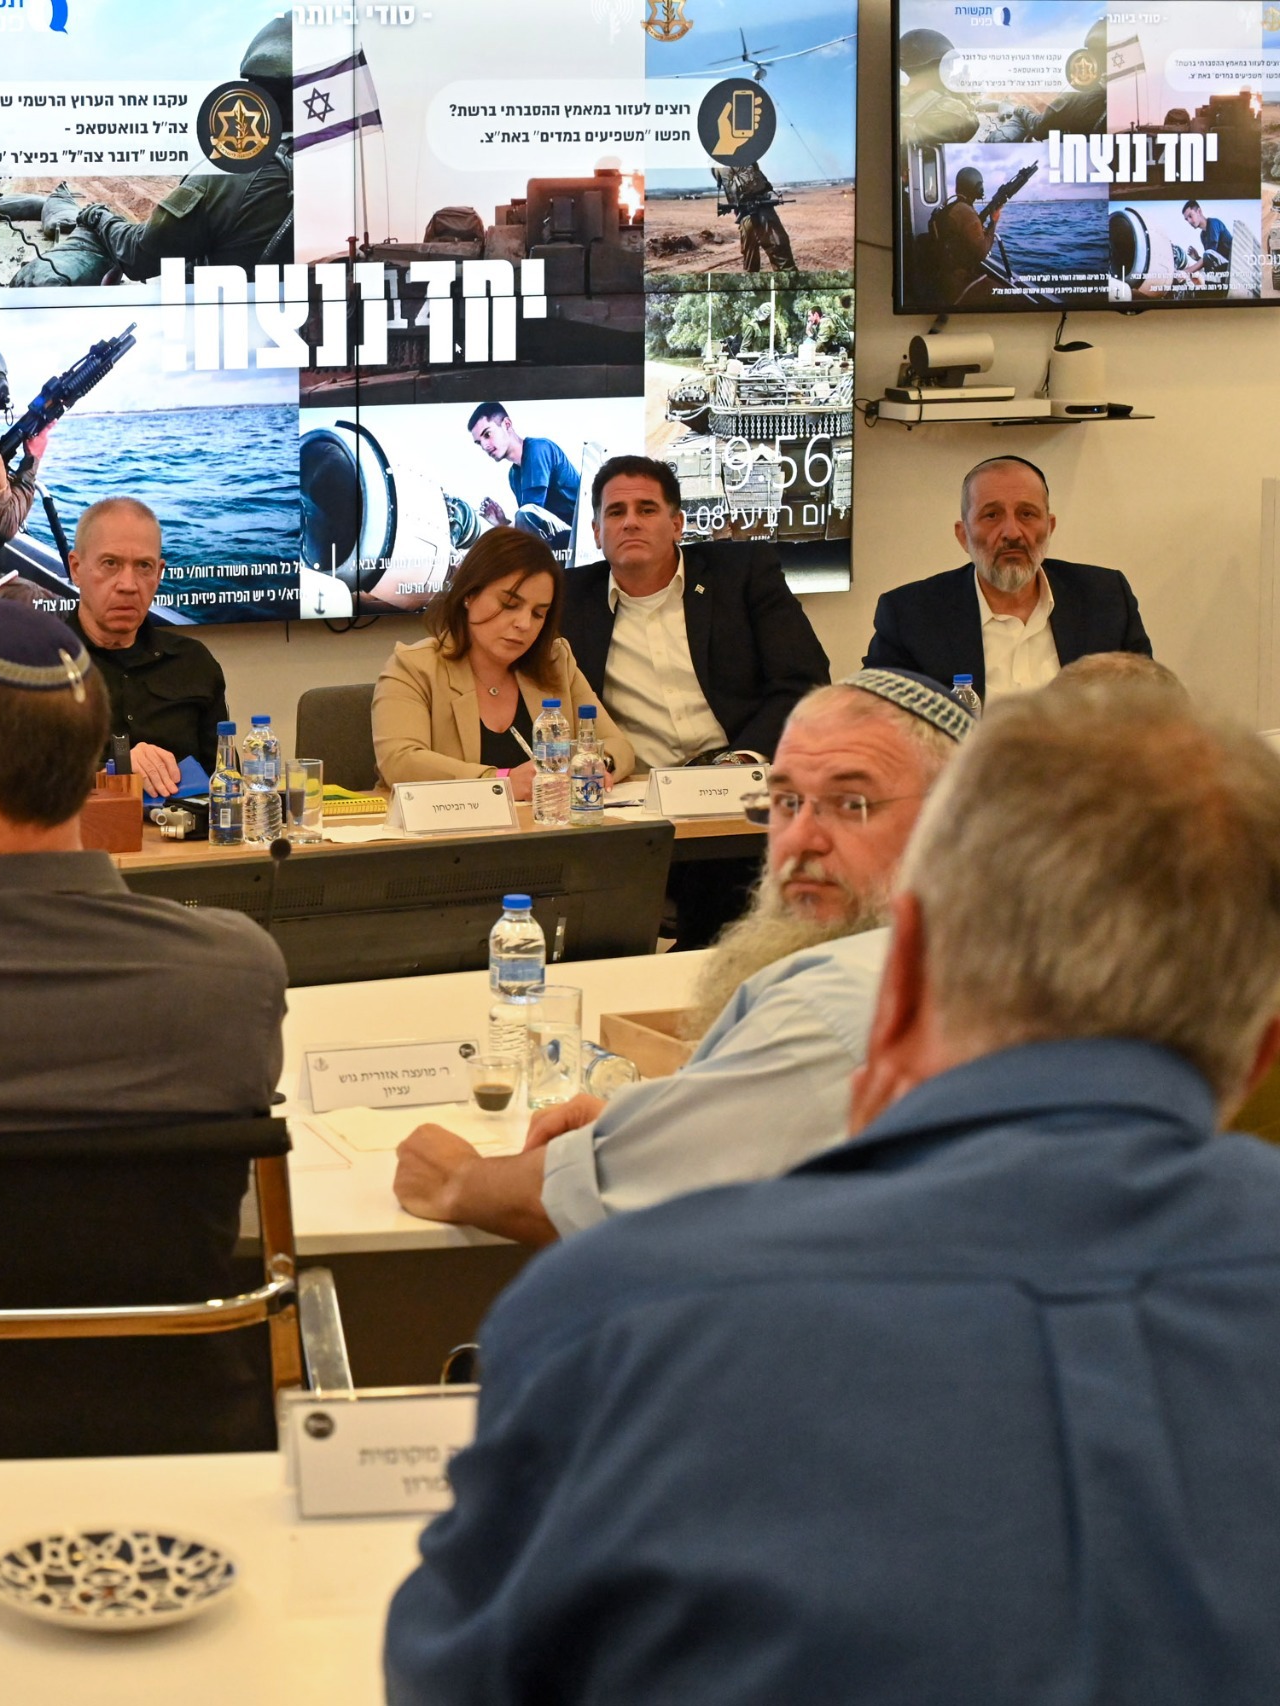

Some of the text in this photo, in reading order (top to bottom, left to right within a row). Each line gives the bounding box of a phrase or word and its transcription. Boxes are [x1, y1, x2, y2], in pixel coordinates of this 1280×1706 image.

[293, 5, 415, 25] סודי ביותר
[954, 6, 992, 17] תקשורת
[971, 17, 992, 26] פנים
[1108, 13, 1161, 24] סודי ביותר
[18, 95, 65, 107] הרשמי
[71, 95, 114, 109] הערוץ
[119, 95, 148, 107] אחר
[153, 94, 188, 109] עקבו
[449, 102, 691, 118] רוצים לעזור במאמץ ההסברתי ברשת?
[76, 121, 188, 135] צה"ל בוואטסאפ
[534, 129, 581, 143] במדים"
[584, 129, 651, 142] "משפיעים
[655, 130, 691, 141] חפשו
[11, 151, 58, 164] בפיצ'ר
[62, 150, 103, 163] צה"ל"
[108, 150, 145, 163] "דובר
[150, 150, 188, 162] חפשו
[1048, 130, 1146, 183] ננצח!
[1156, 133, 1218, 182] יחד
[160, 257, 547, 371] יחד ננצח!
[706, 433, 833, 491] 19:56
[697, 505, 725, 531] 08
[803, 503, 831, 526] יום
[699, 787, 729, 798] קצרנית
[432, 801, 479, 814] שר הביטחון
[338, 1073, 358, 1084] גוש
[360, 1070, 398, 1082] אזורית
[401, 1067, 437, 1078] מועצה
[383, 1084, 411, 1099] עציון
